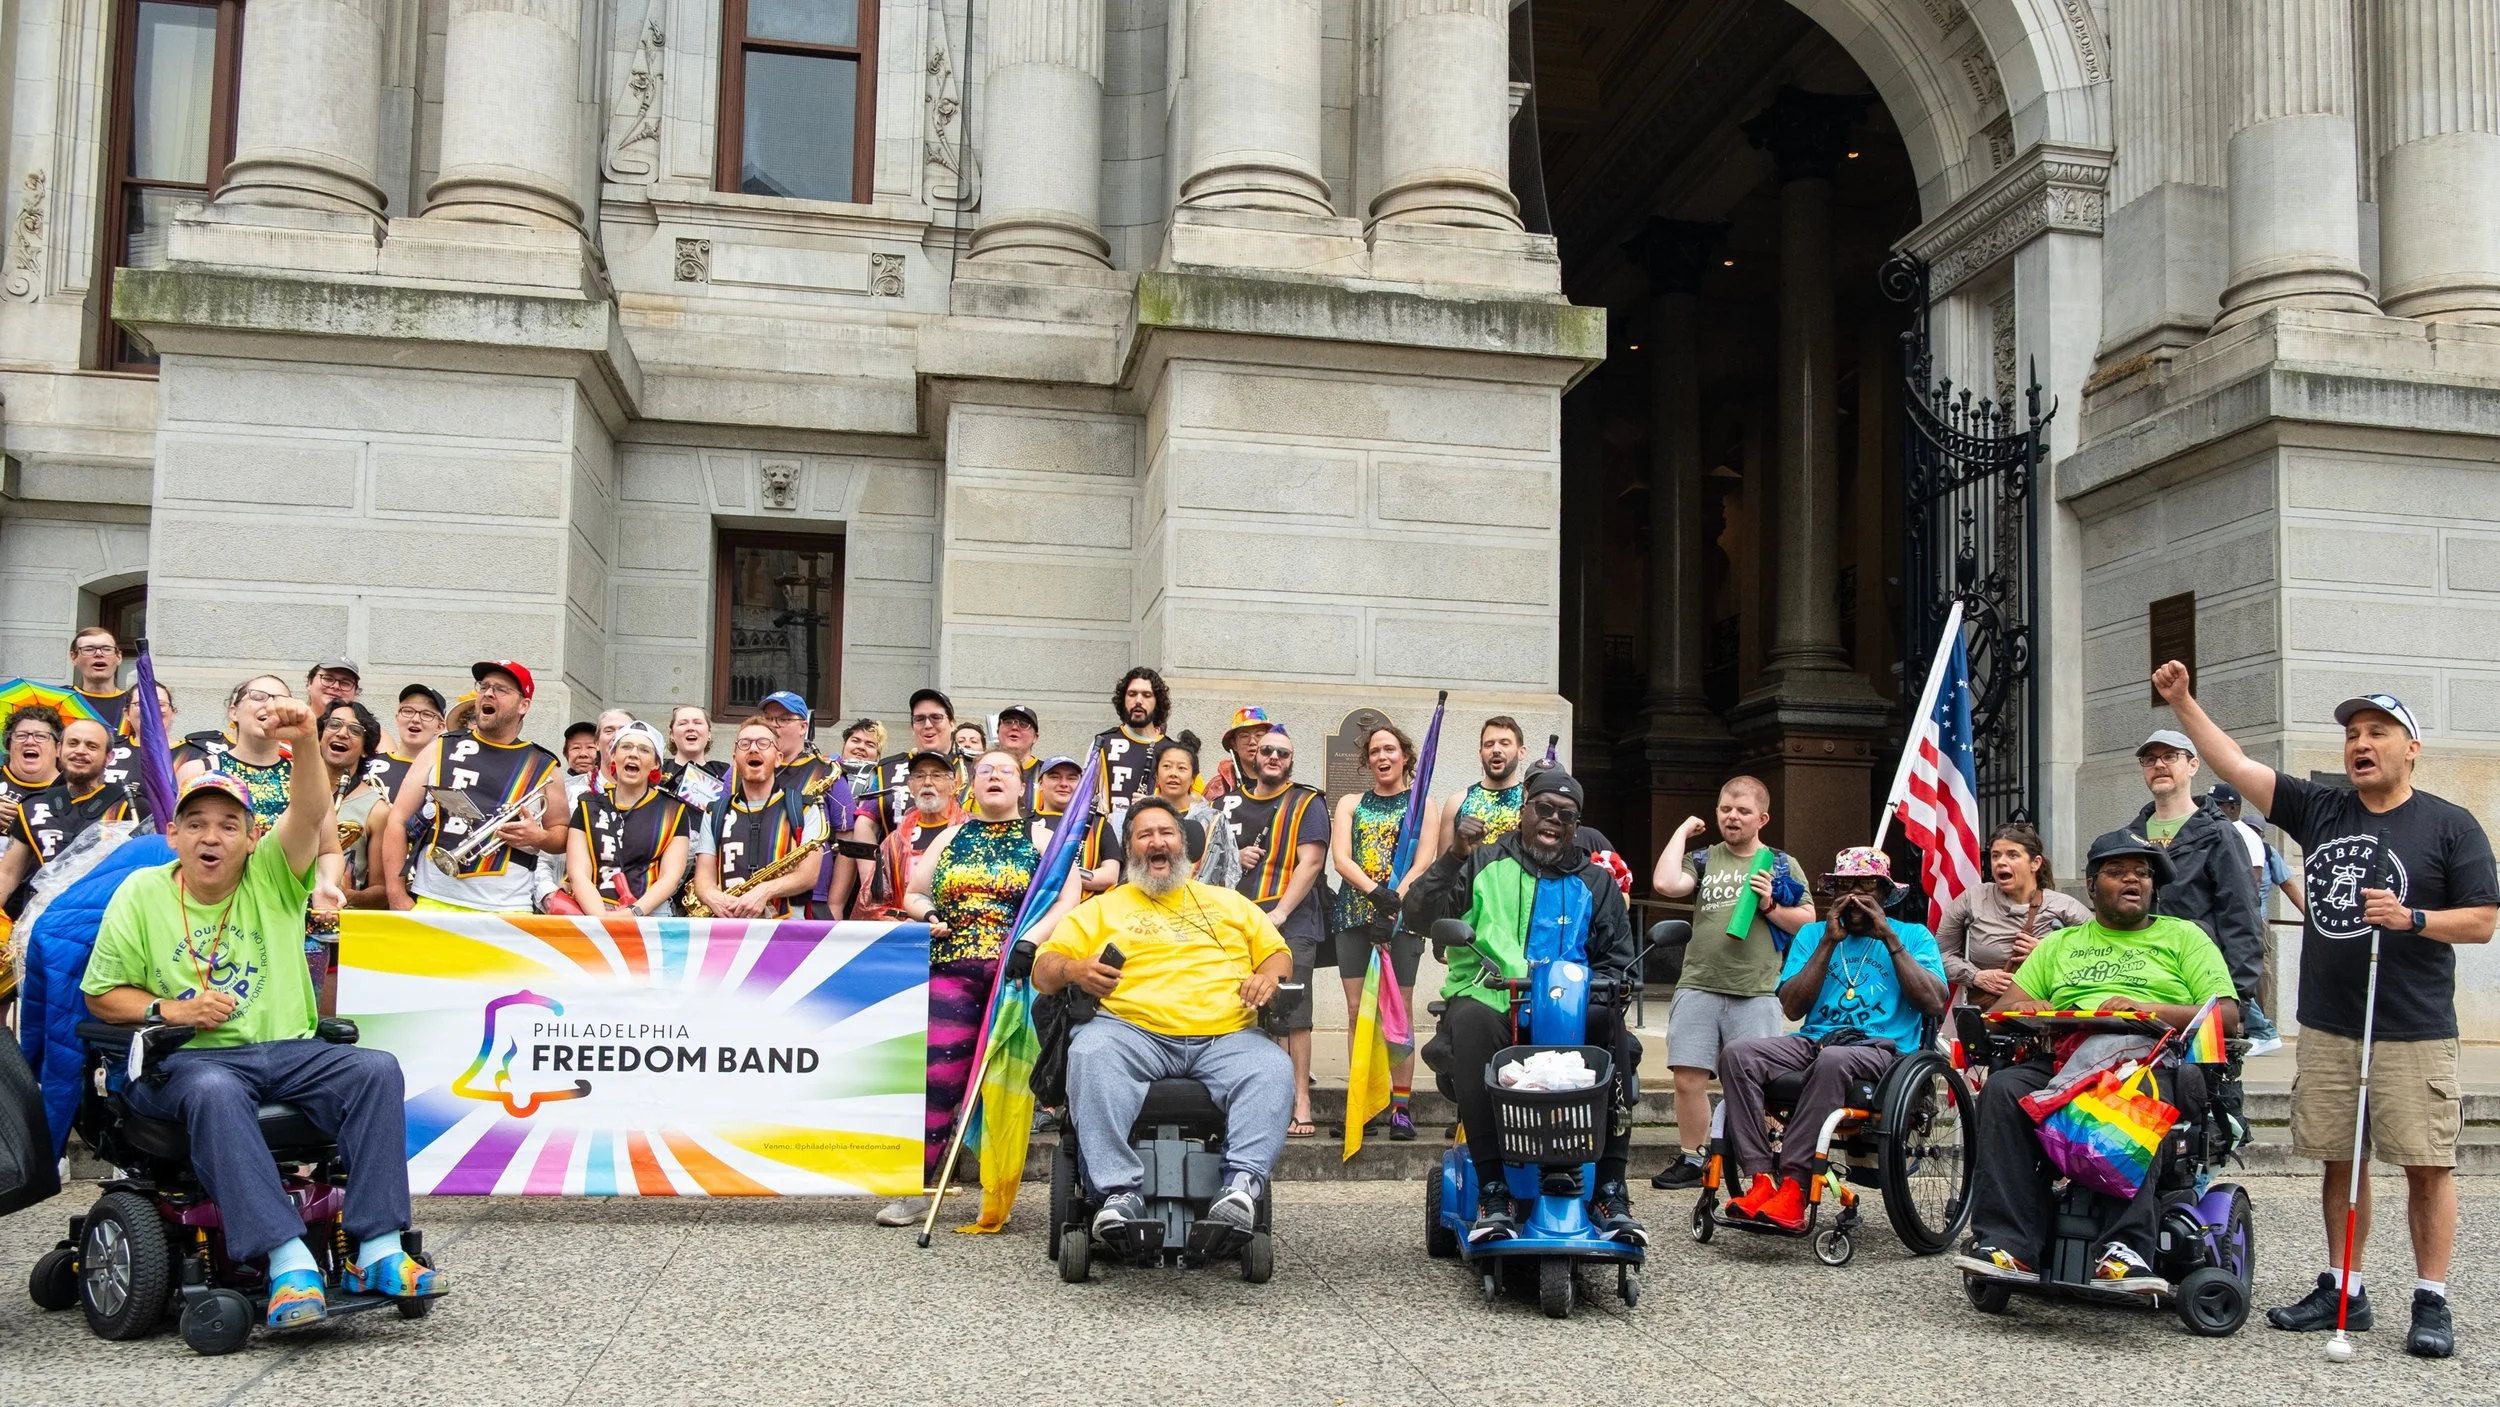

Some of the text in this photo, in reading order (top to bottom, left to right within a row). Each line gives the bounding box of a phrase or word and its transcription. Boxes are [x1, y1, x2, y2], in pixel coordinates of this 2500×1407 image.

[1702, 869, 1731, 886] ove
[173, 924, 245, 962] FREE OUR PPLE
[1818, 1001, 1887, 1026] ADAPT
[533, 1022, 690, 1039] PHILADELPHIA
[532, 1044, 820, 1074] FREEDOM BAND
